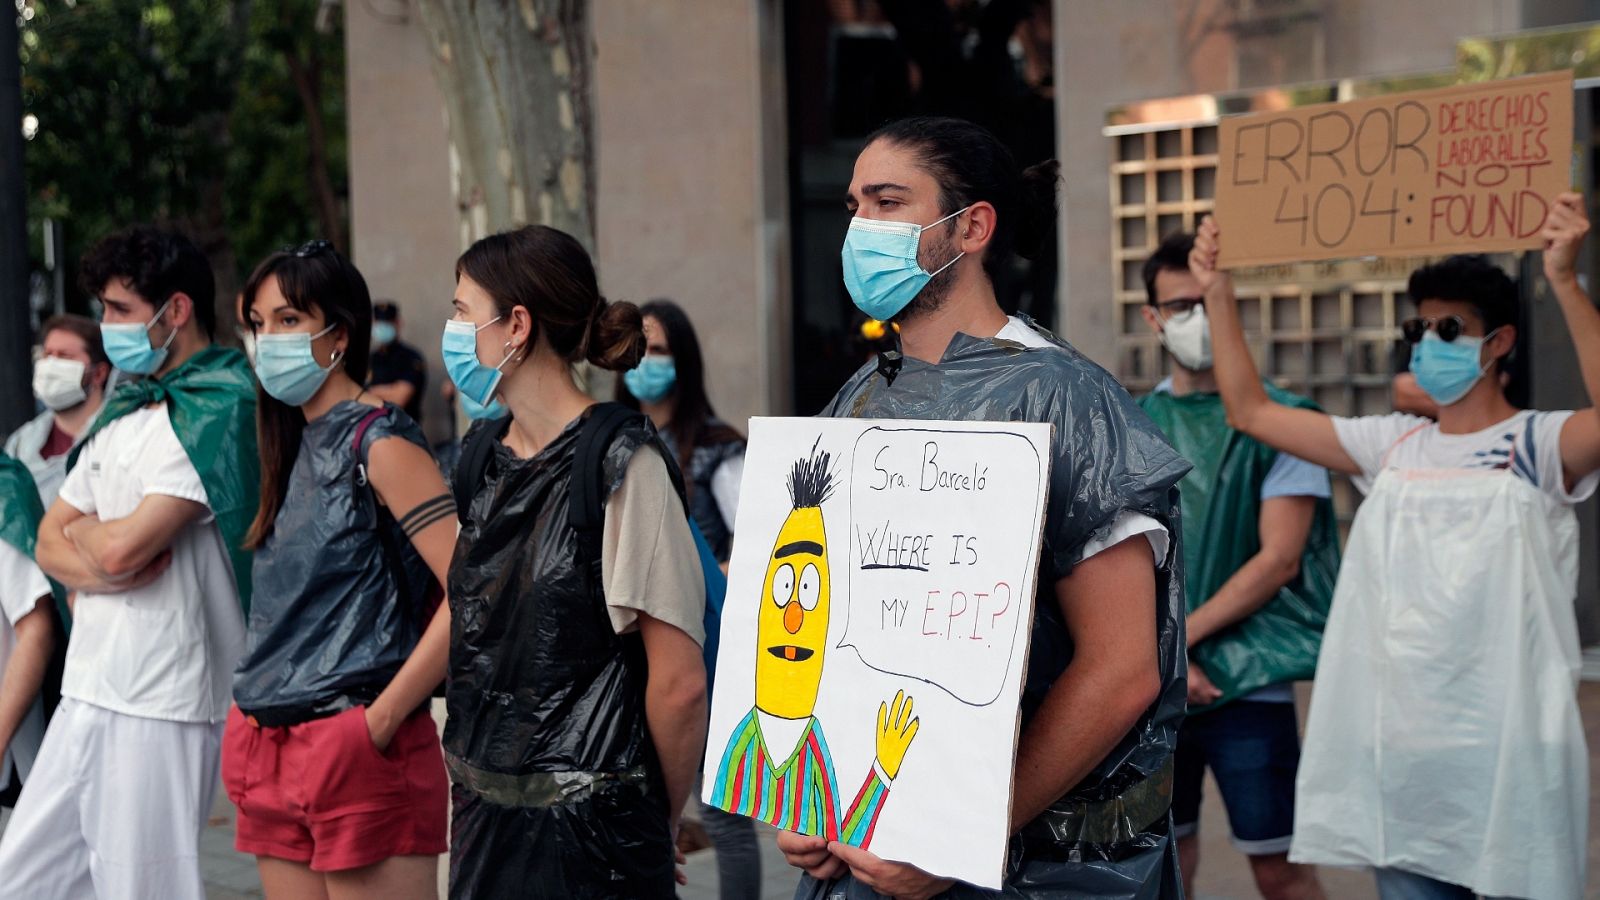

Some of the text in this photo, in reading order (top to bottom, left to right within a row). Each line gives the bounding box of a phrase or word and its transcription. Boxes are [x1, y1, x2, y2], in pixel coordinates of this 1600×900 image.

[1438, 91, 1550, 134] DERECHOS
[1233, 101, 1431, 185] ERROR
[1437, 129, 1548, 168] LABORALES
[1436, 161, 1552, 188] NOT
[1274, 181, 1415, 248] 404:
[1430, 191, 1549, 242] FOUND
[870, 441, 988, 491] Sra. Barceló
[856, 520, 978, 567] WHERE IS
[881, 599, 909, 630] MY
